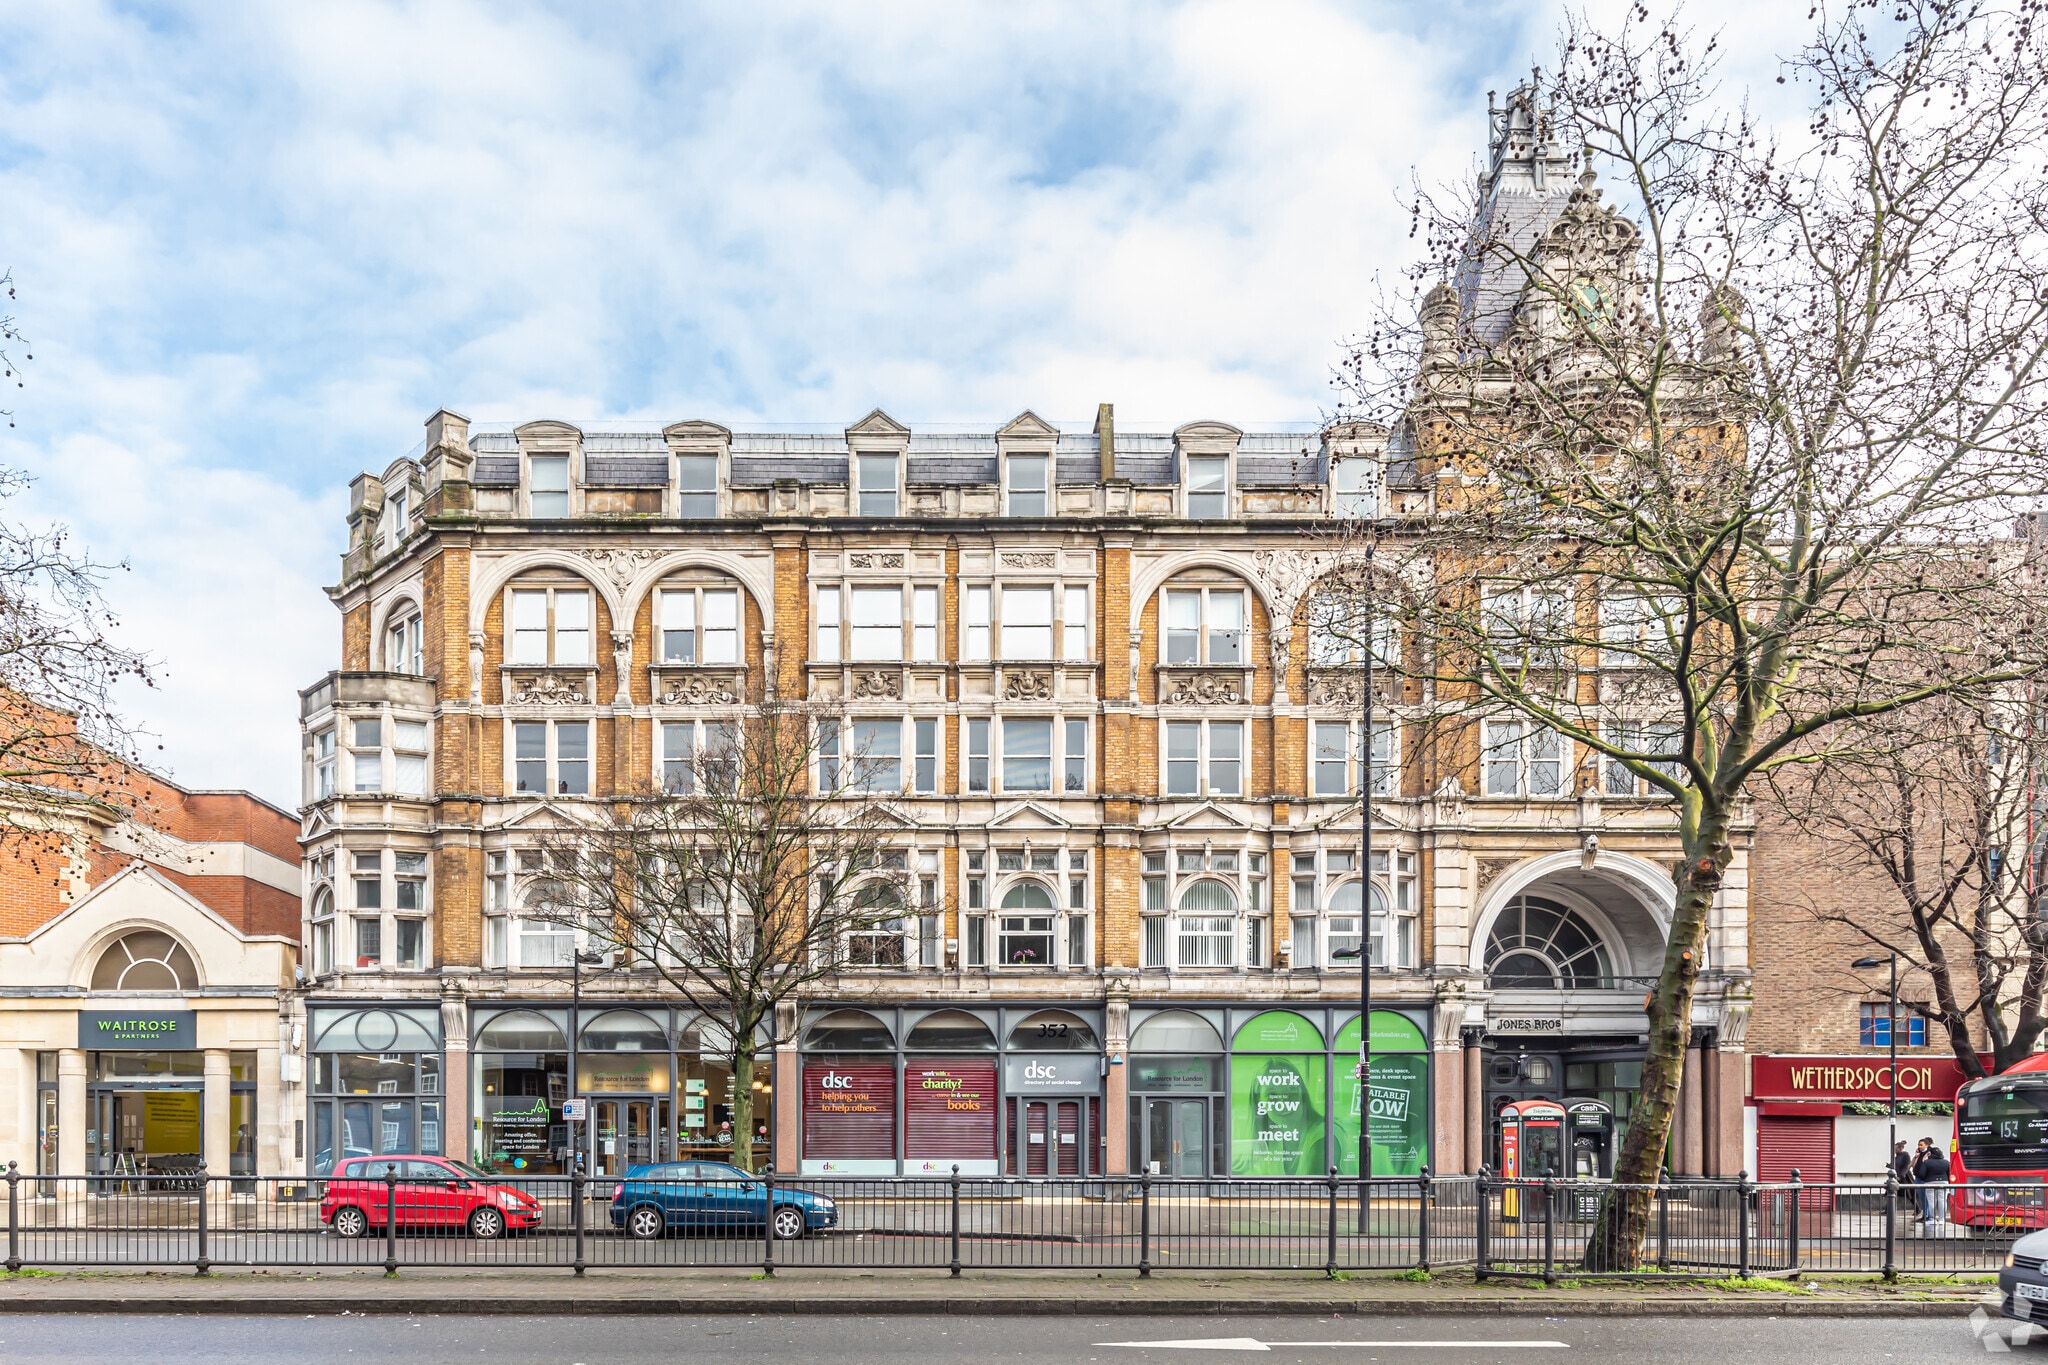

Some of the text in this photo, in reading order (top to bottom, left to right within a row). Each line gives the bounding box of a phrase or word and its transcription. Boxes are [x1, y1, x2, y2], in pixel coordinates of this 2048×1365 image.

[98, 1021, 176, 1031] WAITROSE
[1038, 1024, 1067, 1037] 352
[1497, 1020, 1561, 1030] JONES BROS
[1025, 1060, 1056, 1078] dsc
[822, 1071, 852, 1088] dsc
[1257, 1072, 1300, 1085] work
[1791, 1067, 1932, 1089] WETHERSPOON
[922, 1078, 962, 1092] charity?
[822, 1092, 869, 1102] helping you
[832, 1104, 849, 1114] help
[948, 1100, 980, 1110] books
[1257, 1101, 1300, 1115] grow
[1258, 1129, 1299, 1141] meet
[2001, 1121, 2018, 1137] 153
[823, 1162, 837, 1170] dsc
[923, 1162, 936, 1170] dsc
